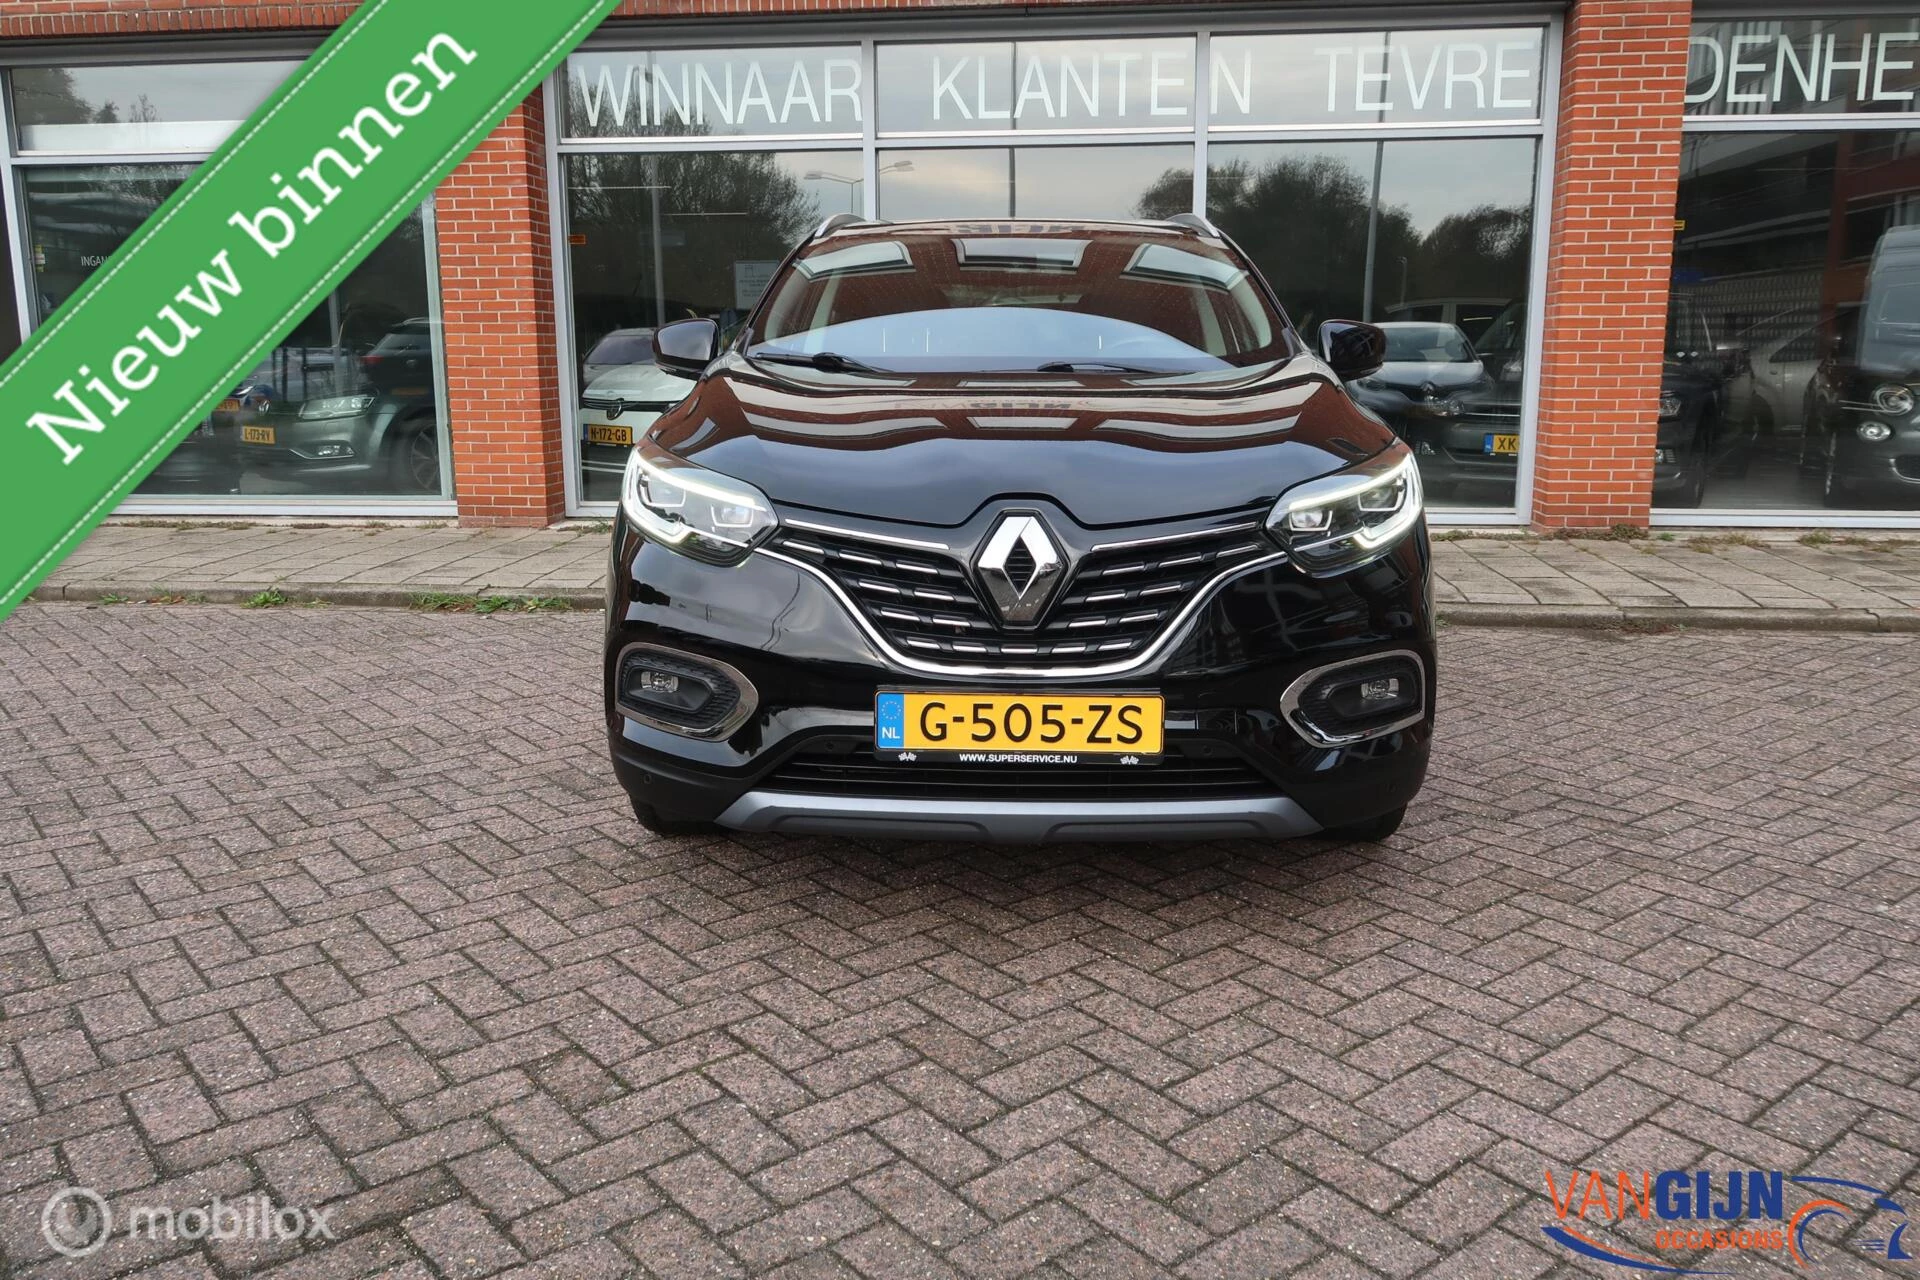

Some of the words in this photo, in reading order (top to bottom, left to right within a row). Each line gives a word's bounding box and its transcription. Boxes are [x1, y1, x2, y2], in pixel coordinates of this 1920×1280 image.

[577, 59, 862, 127] WINNAAR
[1314, 41, 1536, 112] TEVRE
[1684, 32, 1919, 104] DENHE
[881, 727, 900, 739] NL
[919, 701, 1143, 744] G-505-ZS
[959, 753, 1077, 764] WWW.SUPERSERVICE.NU
